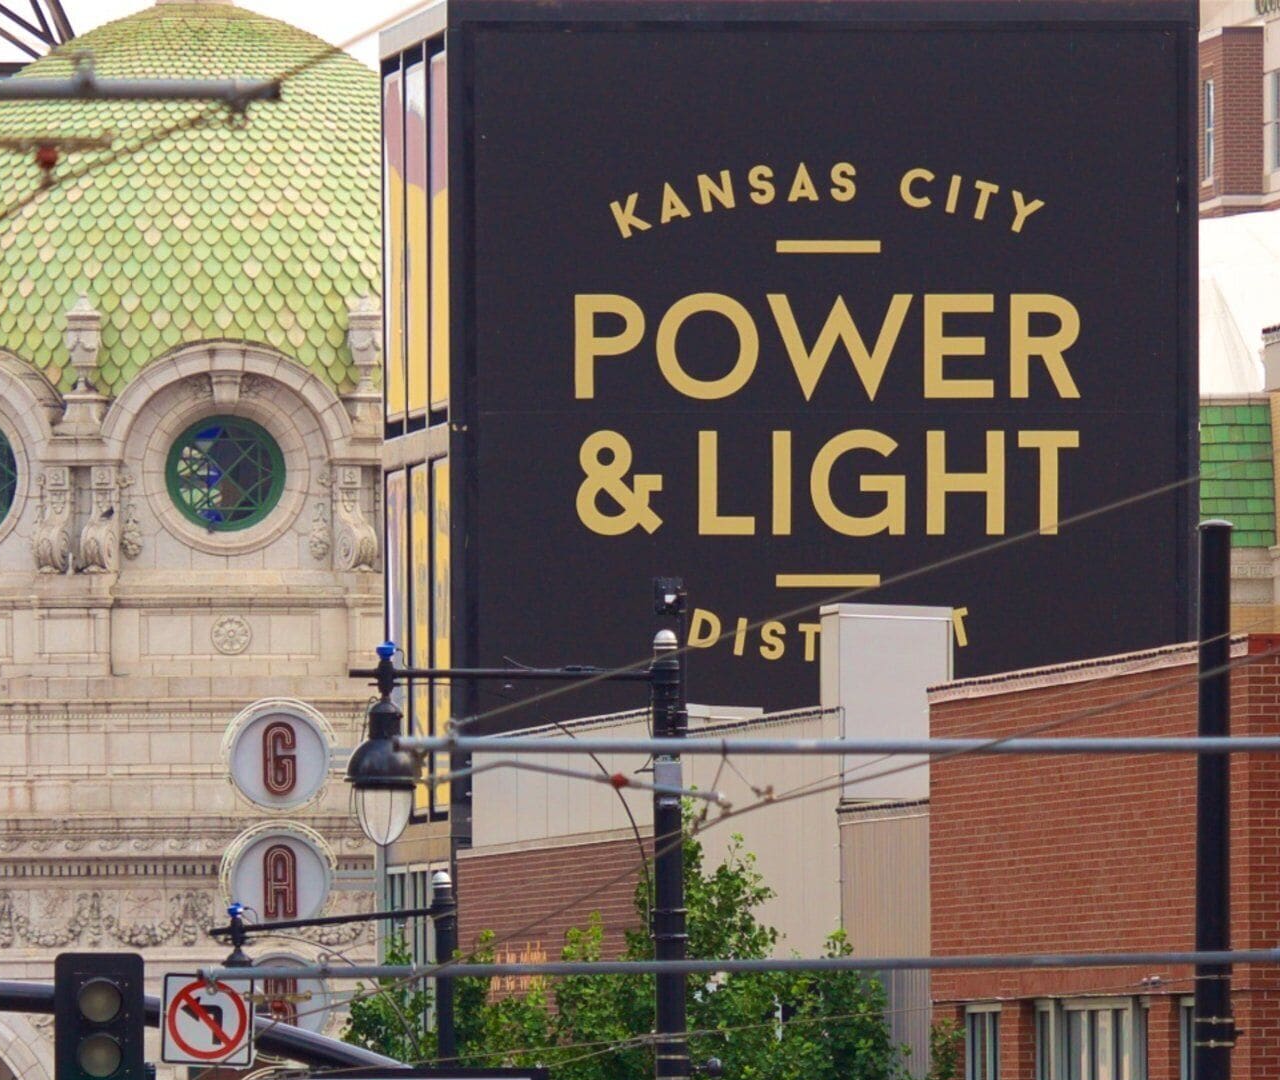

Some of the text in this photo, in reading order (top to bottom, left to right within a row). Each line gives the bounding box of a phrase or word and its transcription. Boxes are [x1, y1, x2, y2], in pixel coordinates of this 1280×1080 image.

[610, 162, 1045, 238] KANSAS CITY
[574, 292, 1081, 401] POWER
[575, 429, 1080, 537] & LIGHT
[687, 607, 969, 662] DISTT
